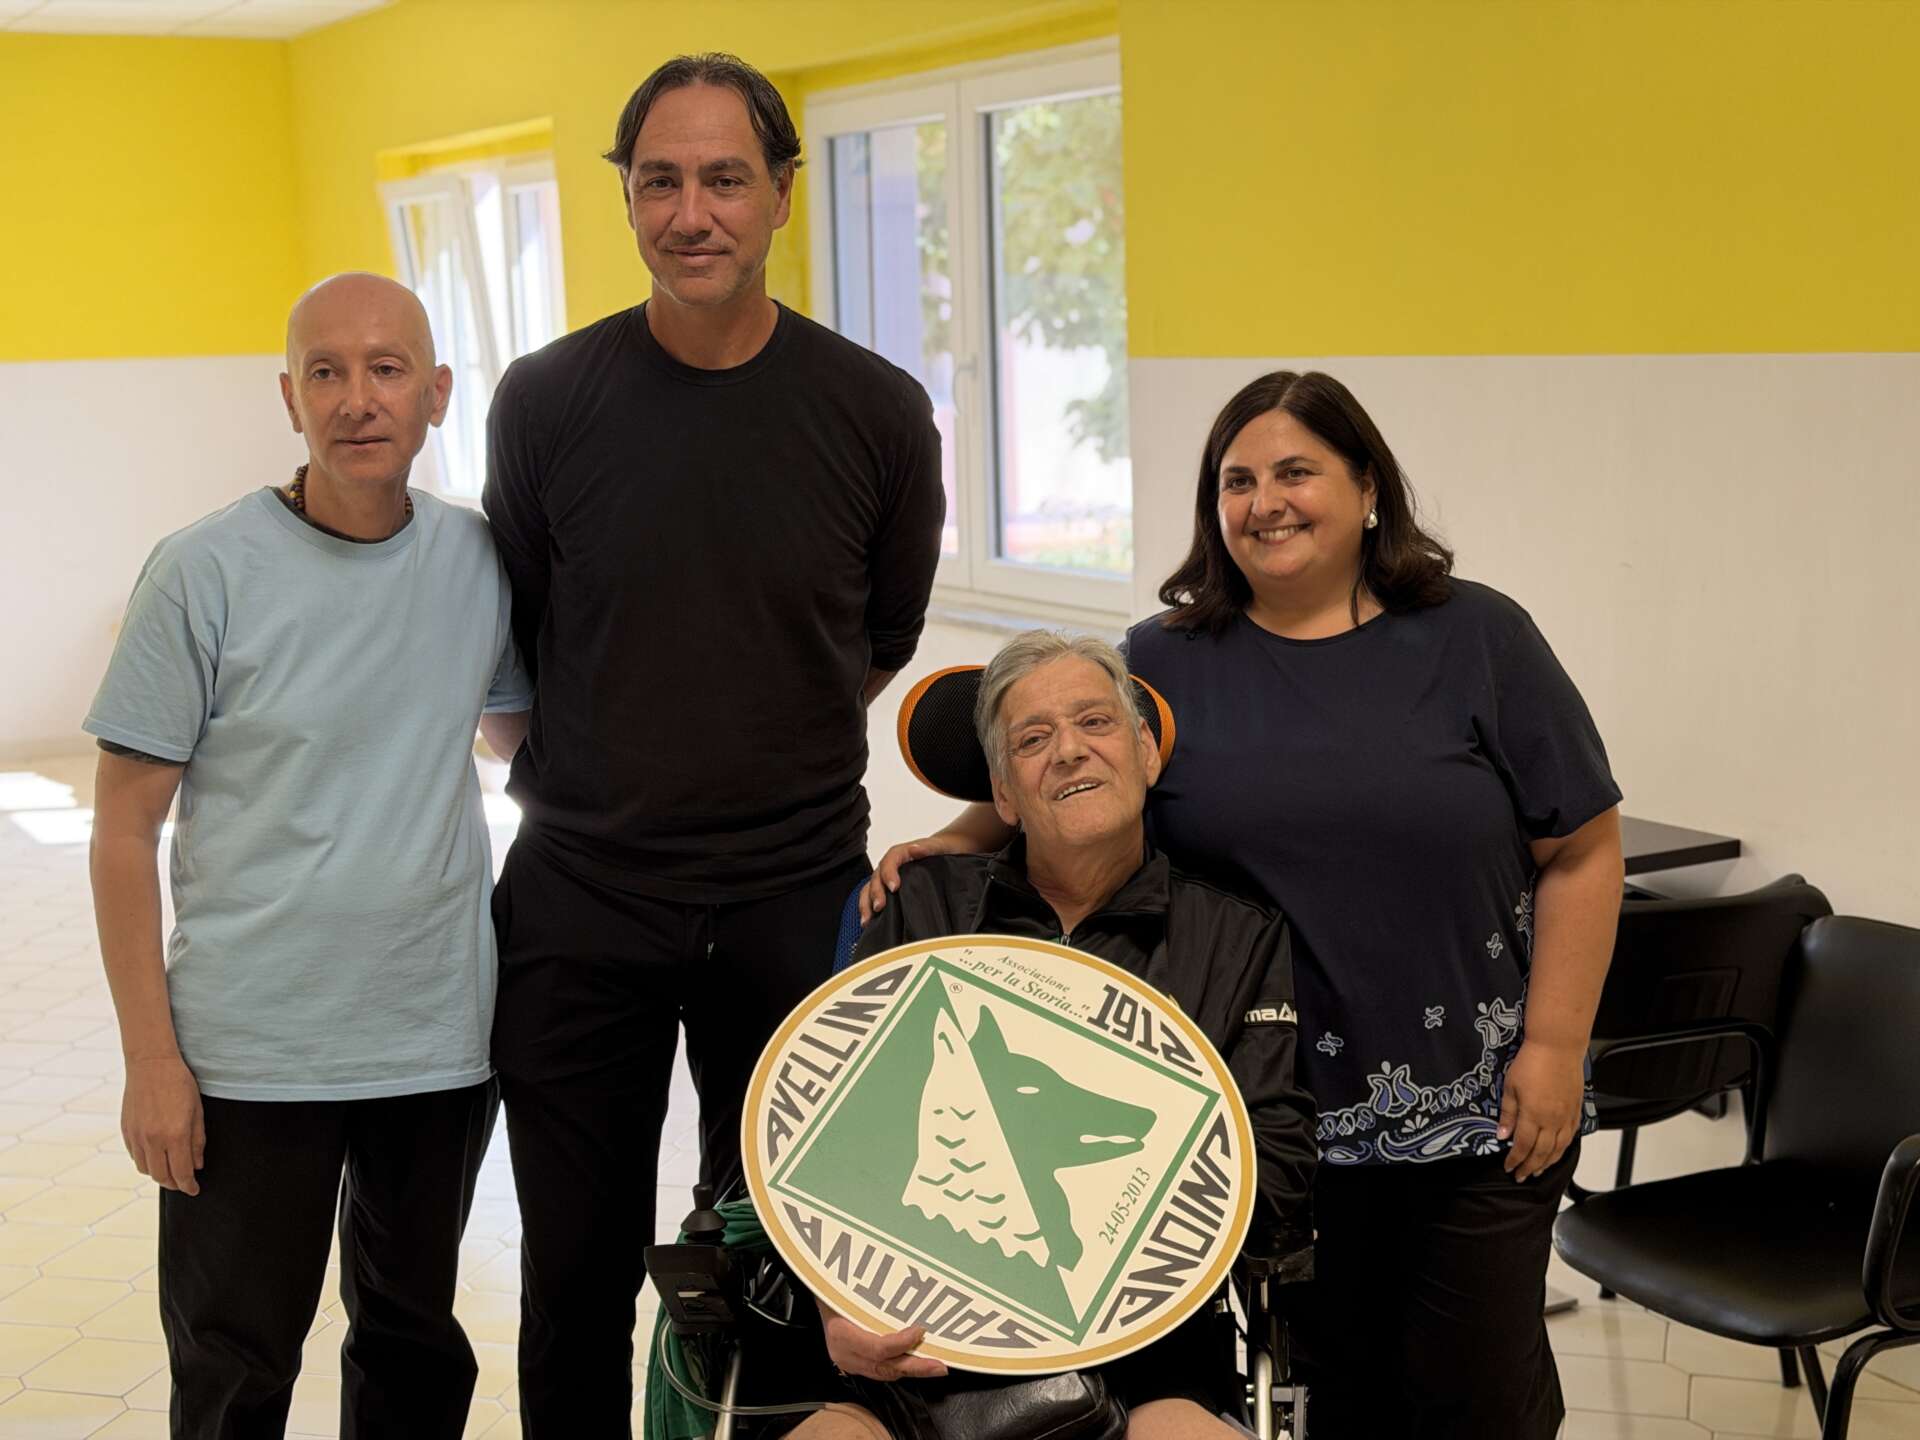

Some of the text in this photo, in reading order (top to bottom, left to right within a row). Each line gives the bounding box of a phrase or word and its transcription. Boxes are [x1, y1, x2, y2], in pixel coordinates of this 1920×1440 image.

[998, 956, 1071, 993] Associazione
[1003, 971, 1021, 987] la
[767, 964, 913, 1167] AVELLINO
[1088, 984, 1203, 1077] 1912
[1096, 1111, 1231, 1334] UNIONE
[1098, 1167, 1151, 1245] 24-05-2013
[782, 1200, 1052, 1349] SPORTIVA
